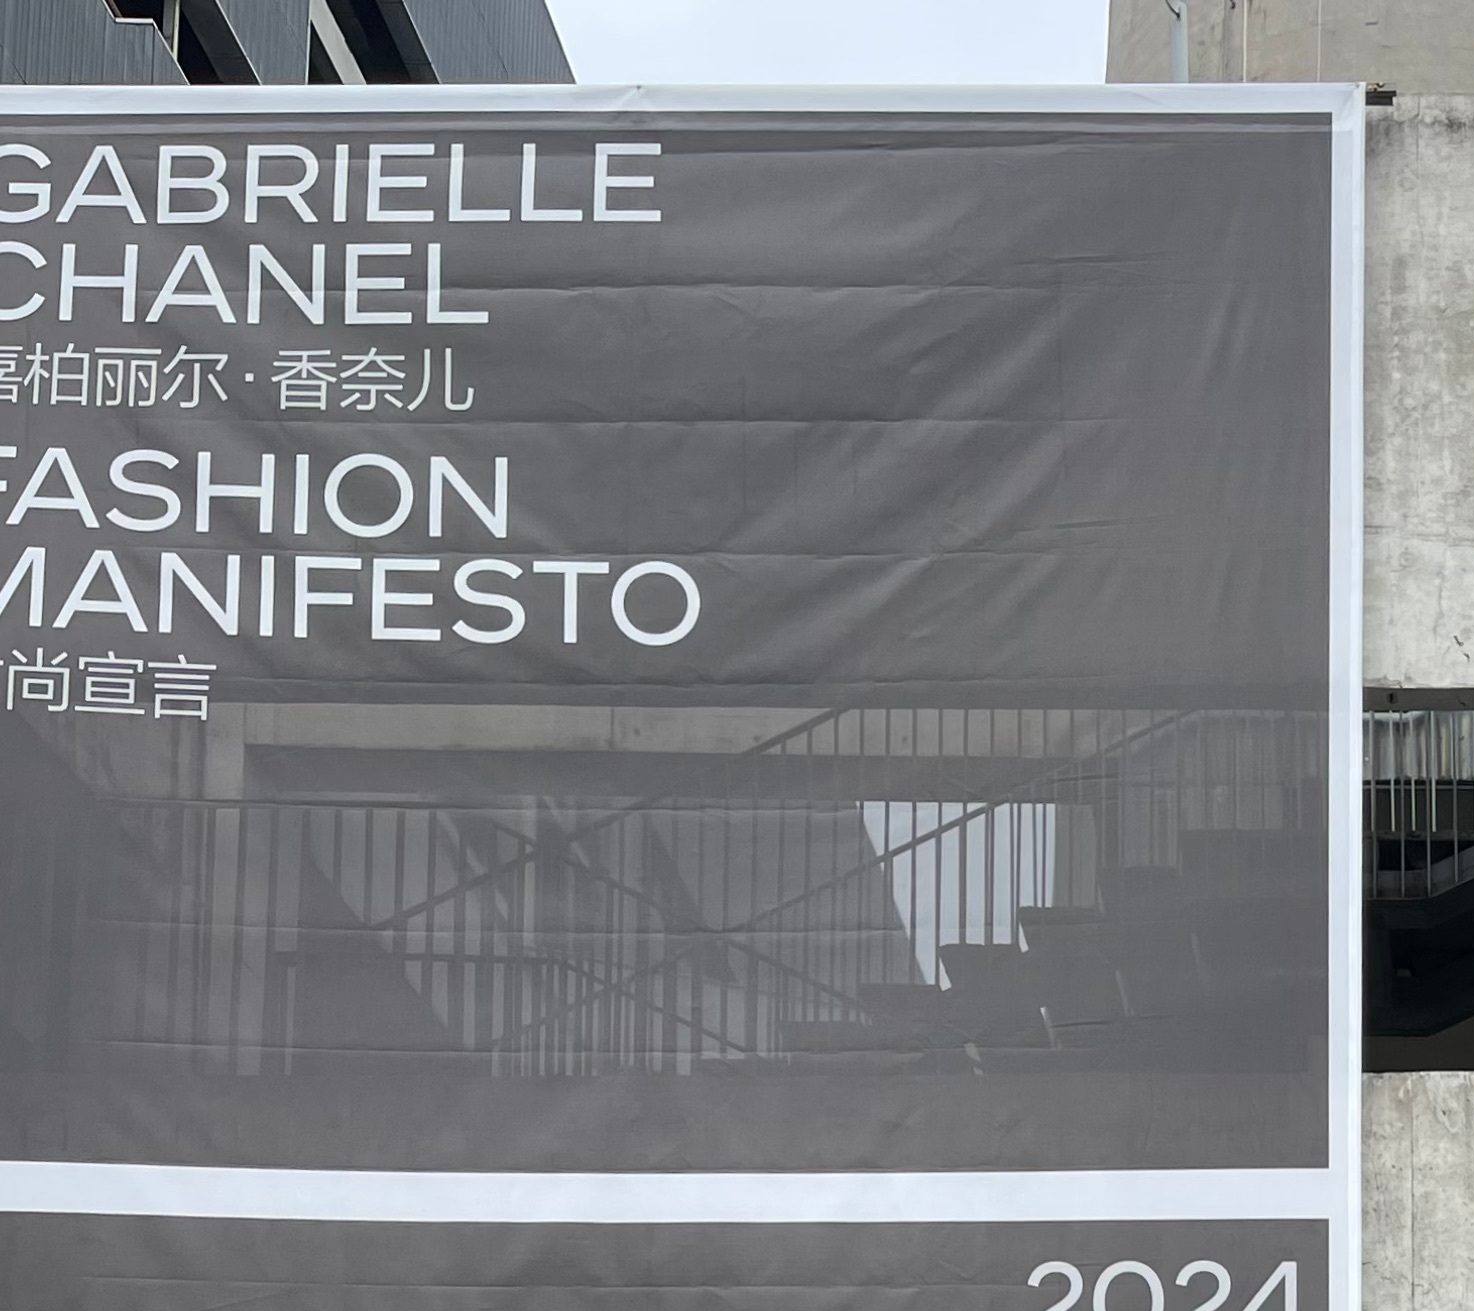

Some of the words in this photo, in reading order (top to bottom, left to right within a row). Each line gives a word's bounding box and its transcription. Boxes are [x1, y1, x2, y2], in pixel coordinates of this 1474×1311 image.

[0, 143, 661, 224] GABRIELLE
[0, 241, 488, 324] CHANEL
[0, 445, 508, 538] ASHION
[0, 648, 217, 720] 尚宣言
